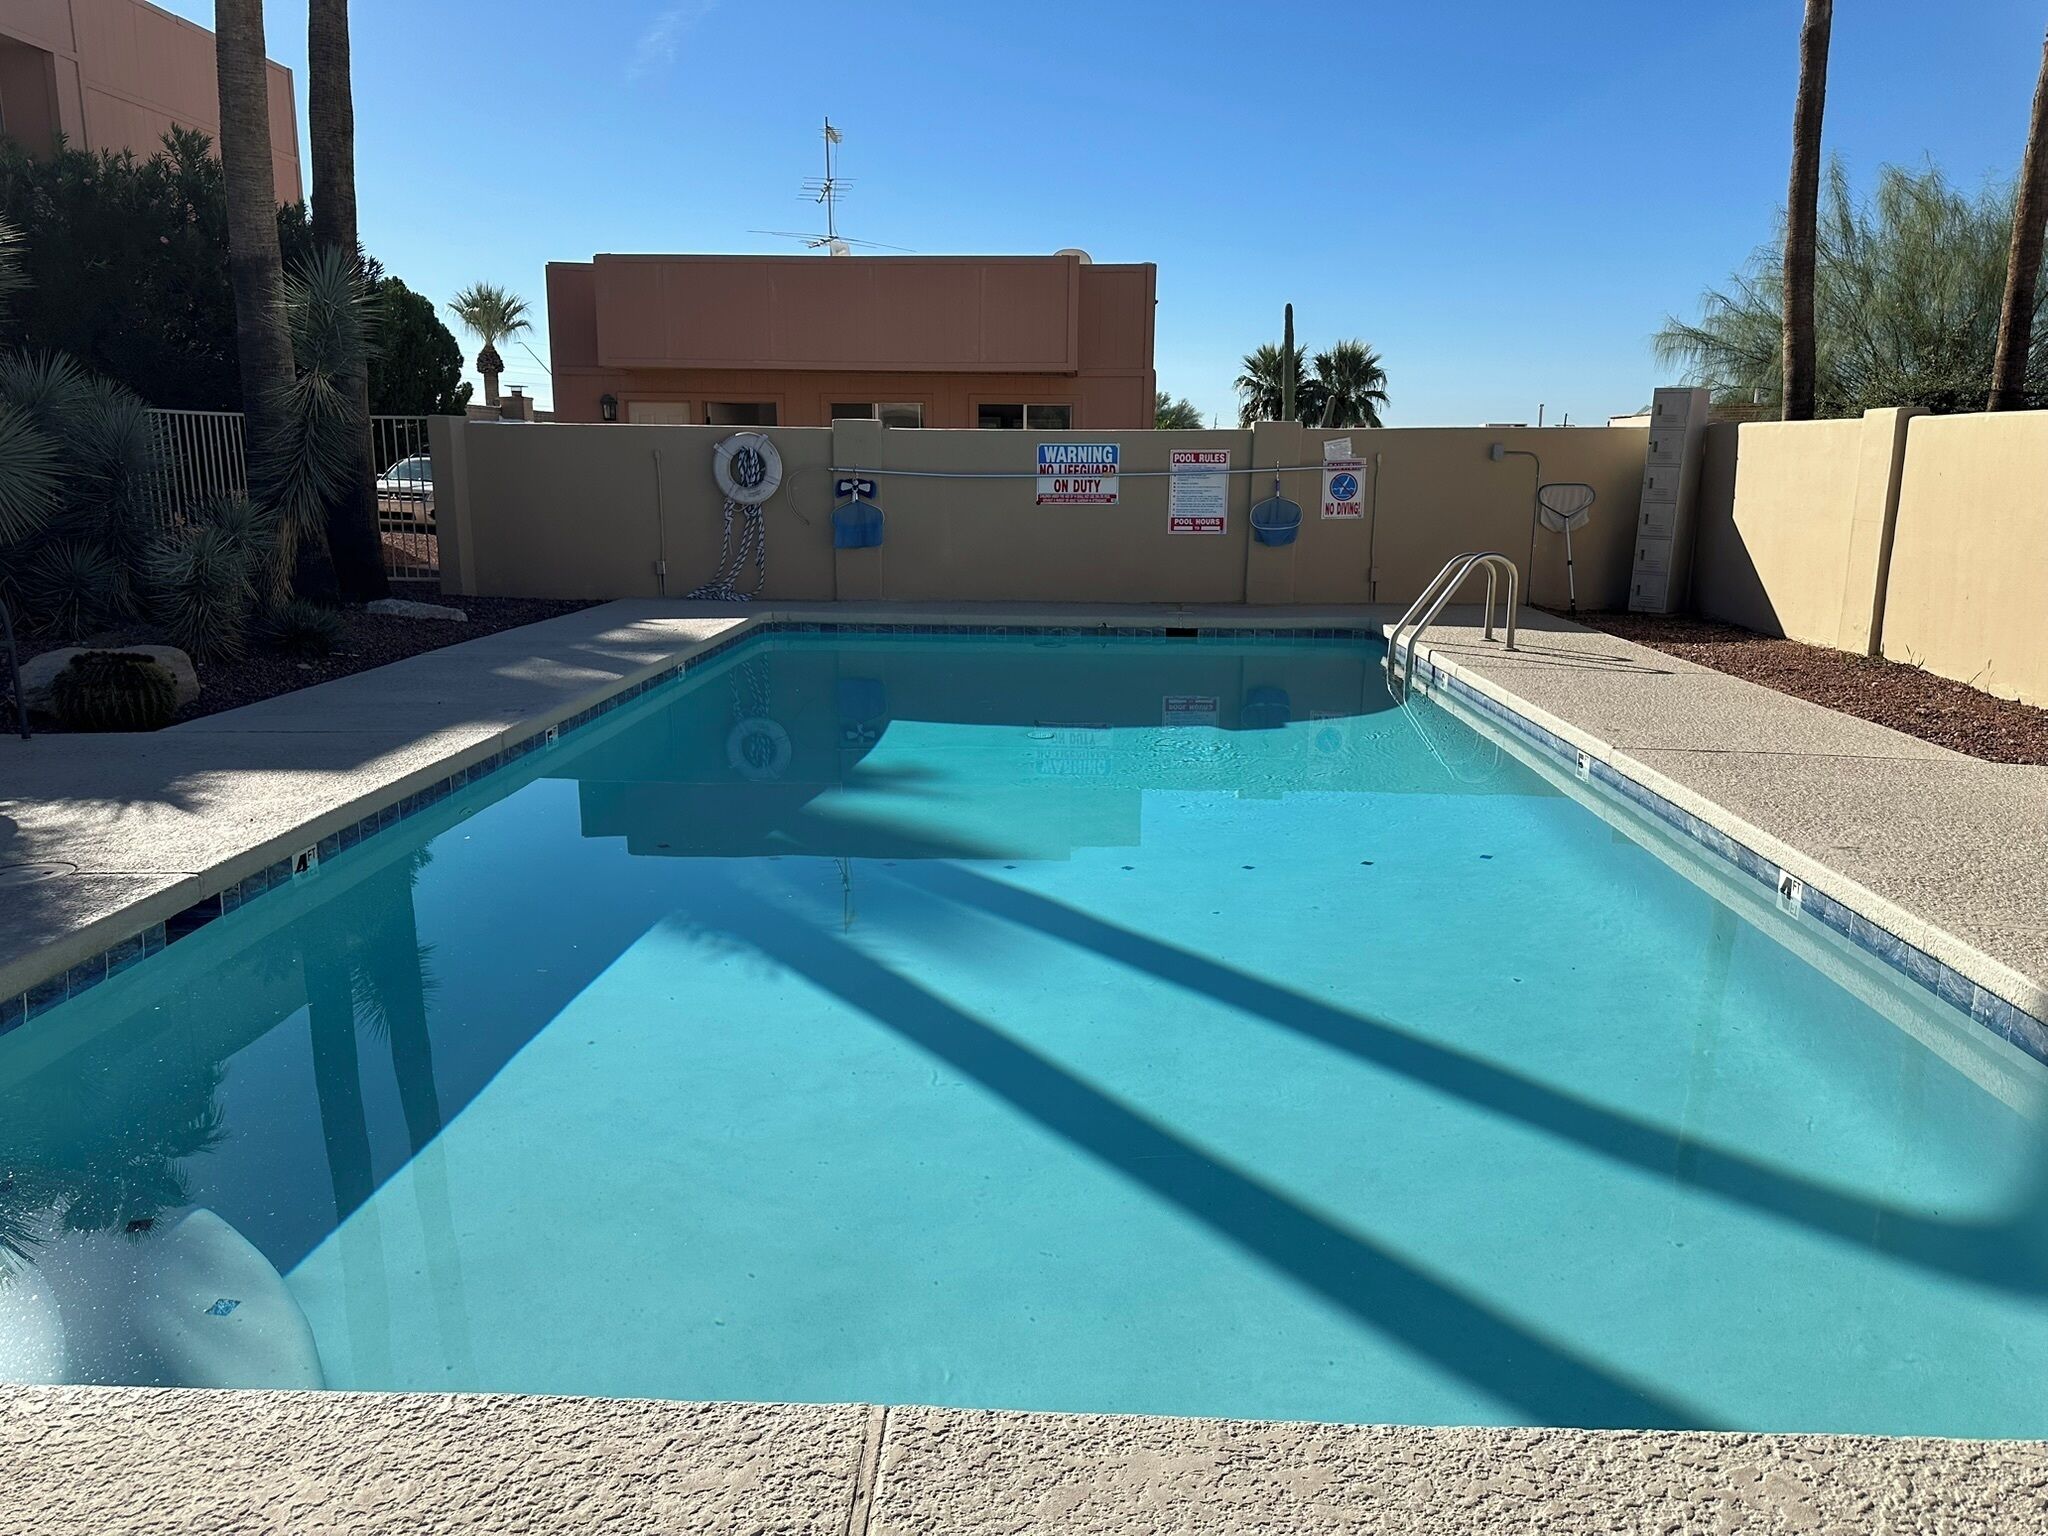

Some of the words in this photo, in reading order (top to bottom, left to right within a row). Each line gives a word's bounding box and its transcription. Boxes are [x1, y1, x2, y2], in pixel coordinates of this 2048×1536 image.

[1044, 446, 1113, 463] WARNING
[1174, 453, 1196, 463] POOL
[1198, 453, 1225, 463] RULES
[1040, 464, 1054, 476] NO
[1054, 479, 1069, 493] ON
[1073, 479, 1101, 493] DUTY
[1325, 502, 1335, 516] NO
[295, 852, 309, 874] 4
[307, 846, 316, 861] FT
[1780, 876, 1792, 901] 4
[1792, 880, 1801, 895] FT
